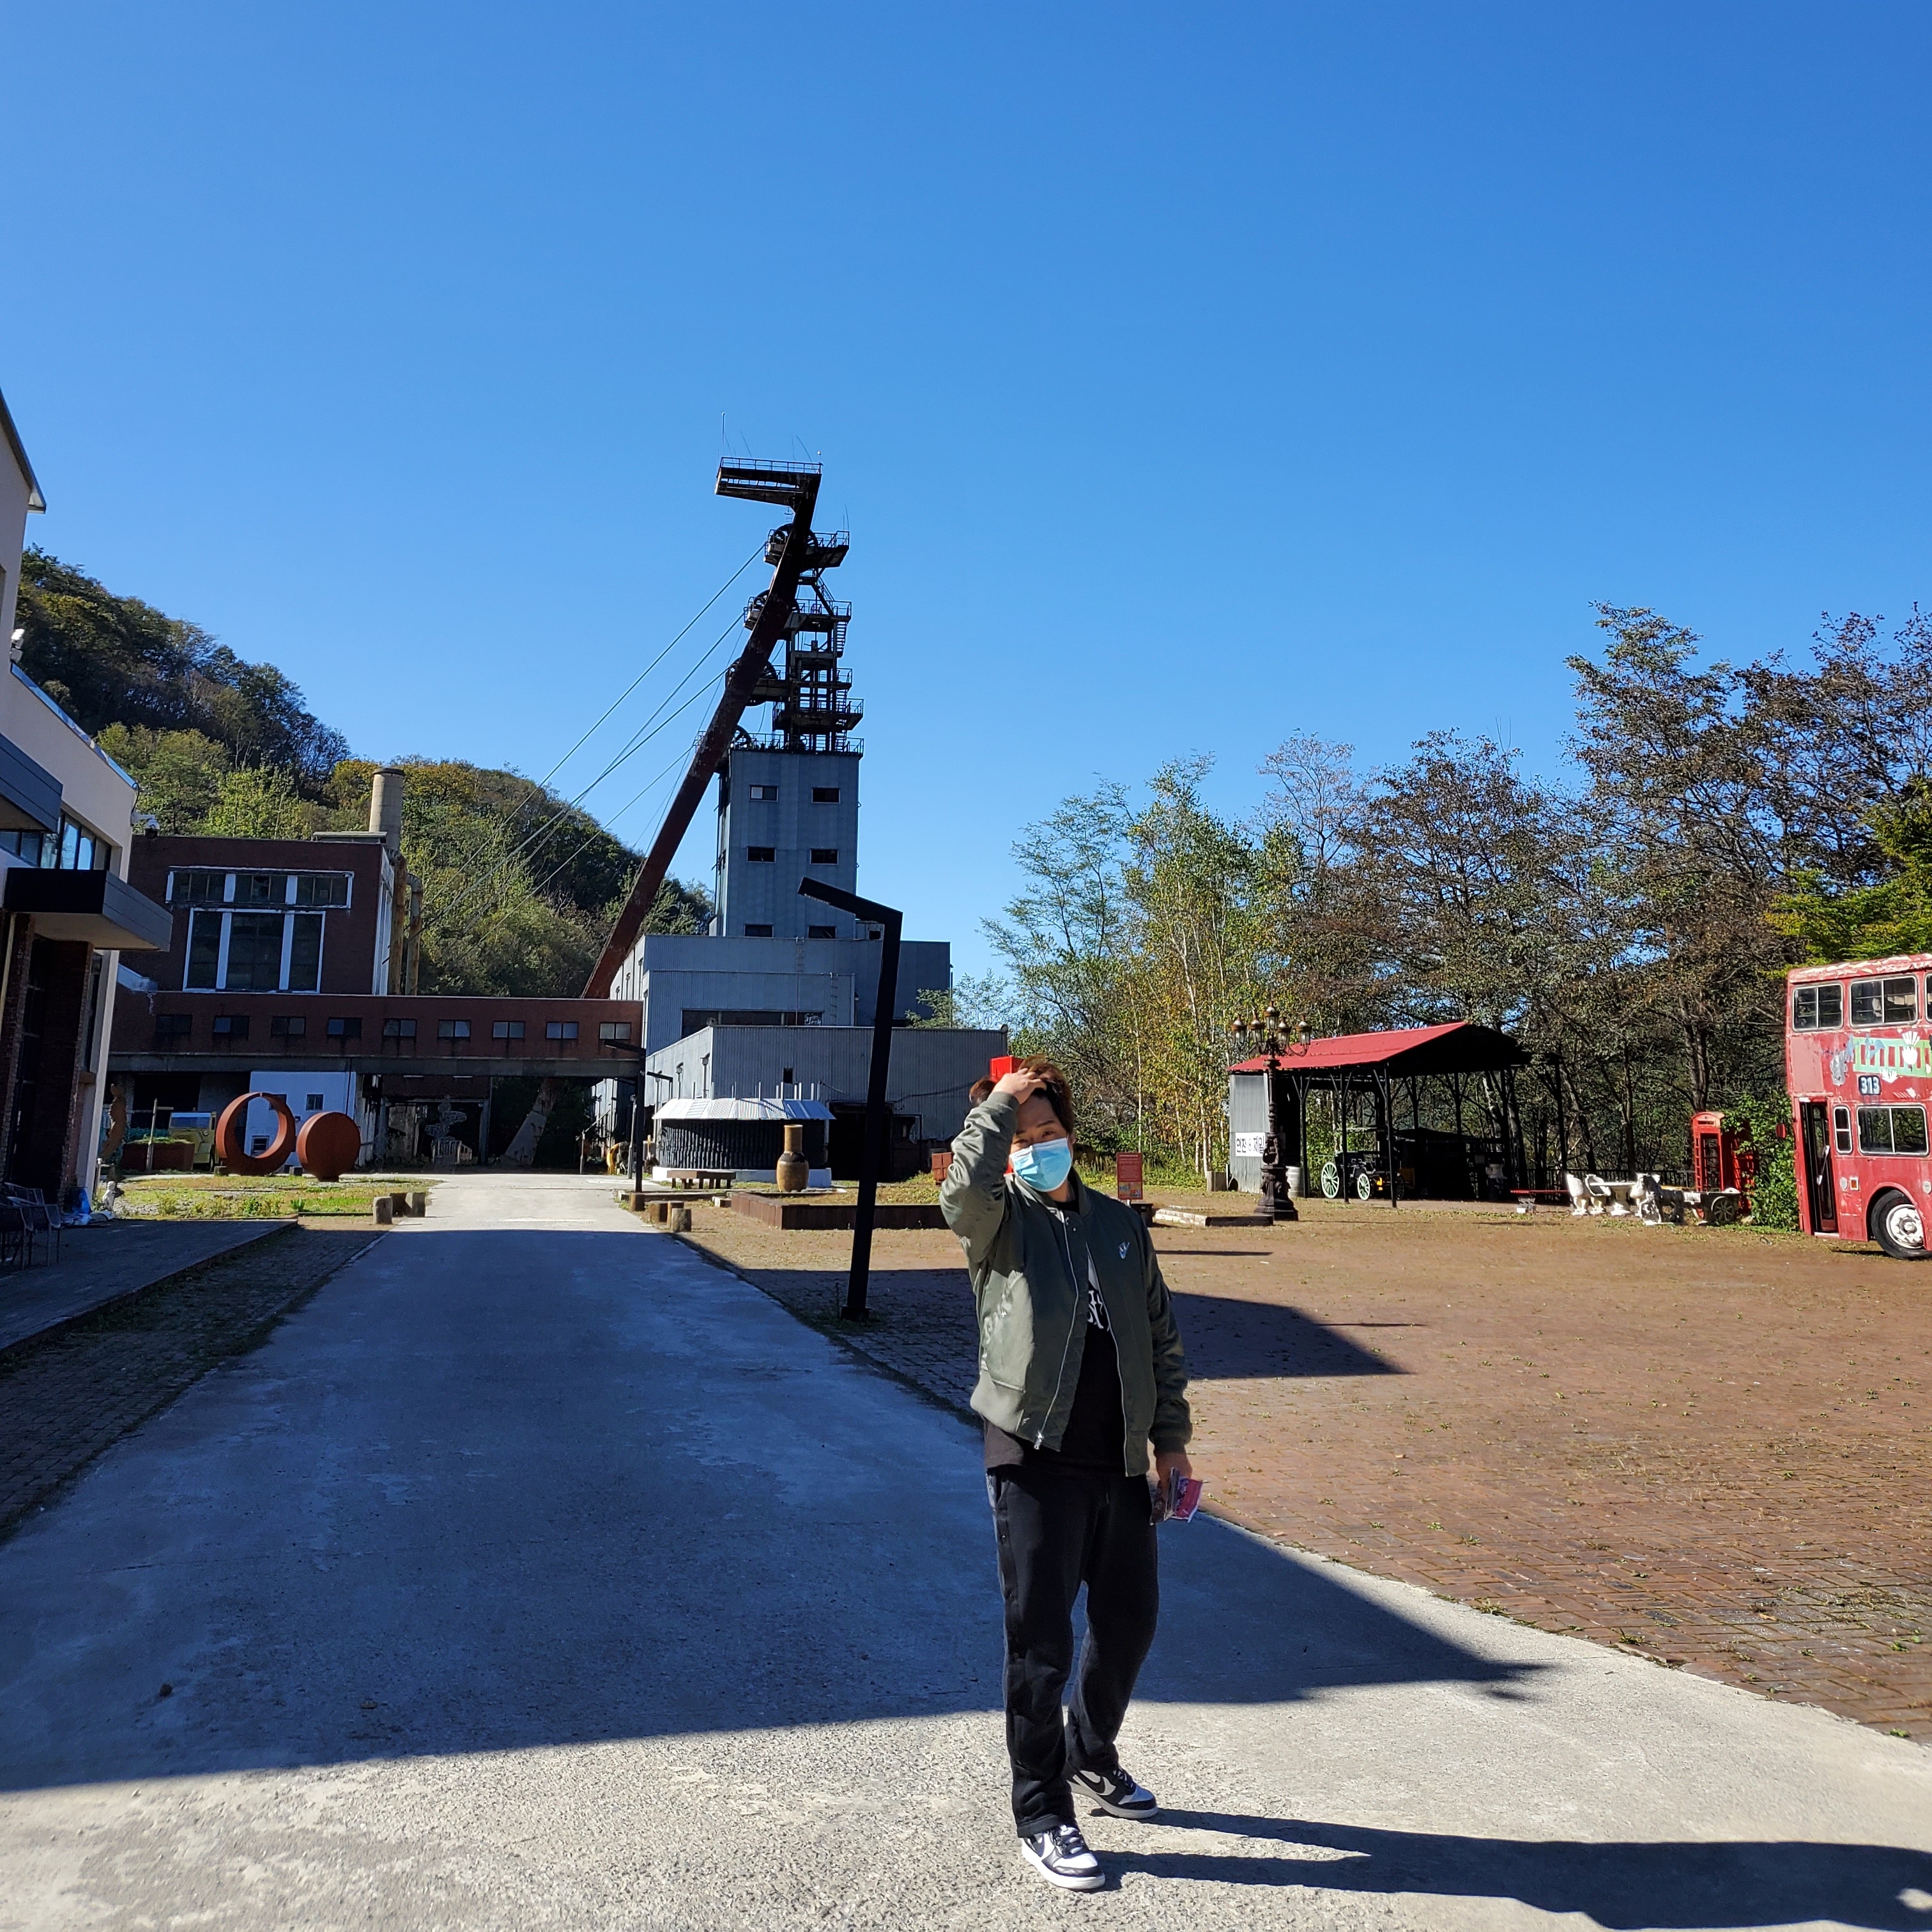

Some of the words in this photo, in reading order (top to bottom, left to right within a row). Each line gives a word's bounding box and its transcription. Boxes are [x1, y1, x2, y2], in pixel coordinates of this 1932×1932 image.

[1860, 1077, 1880, 1094] 313
[1236, 1137, 1246, 1153] 안전
[1253, 1135, 1264, 1154] 제일
